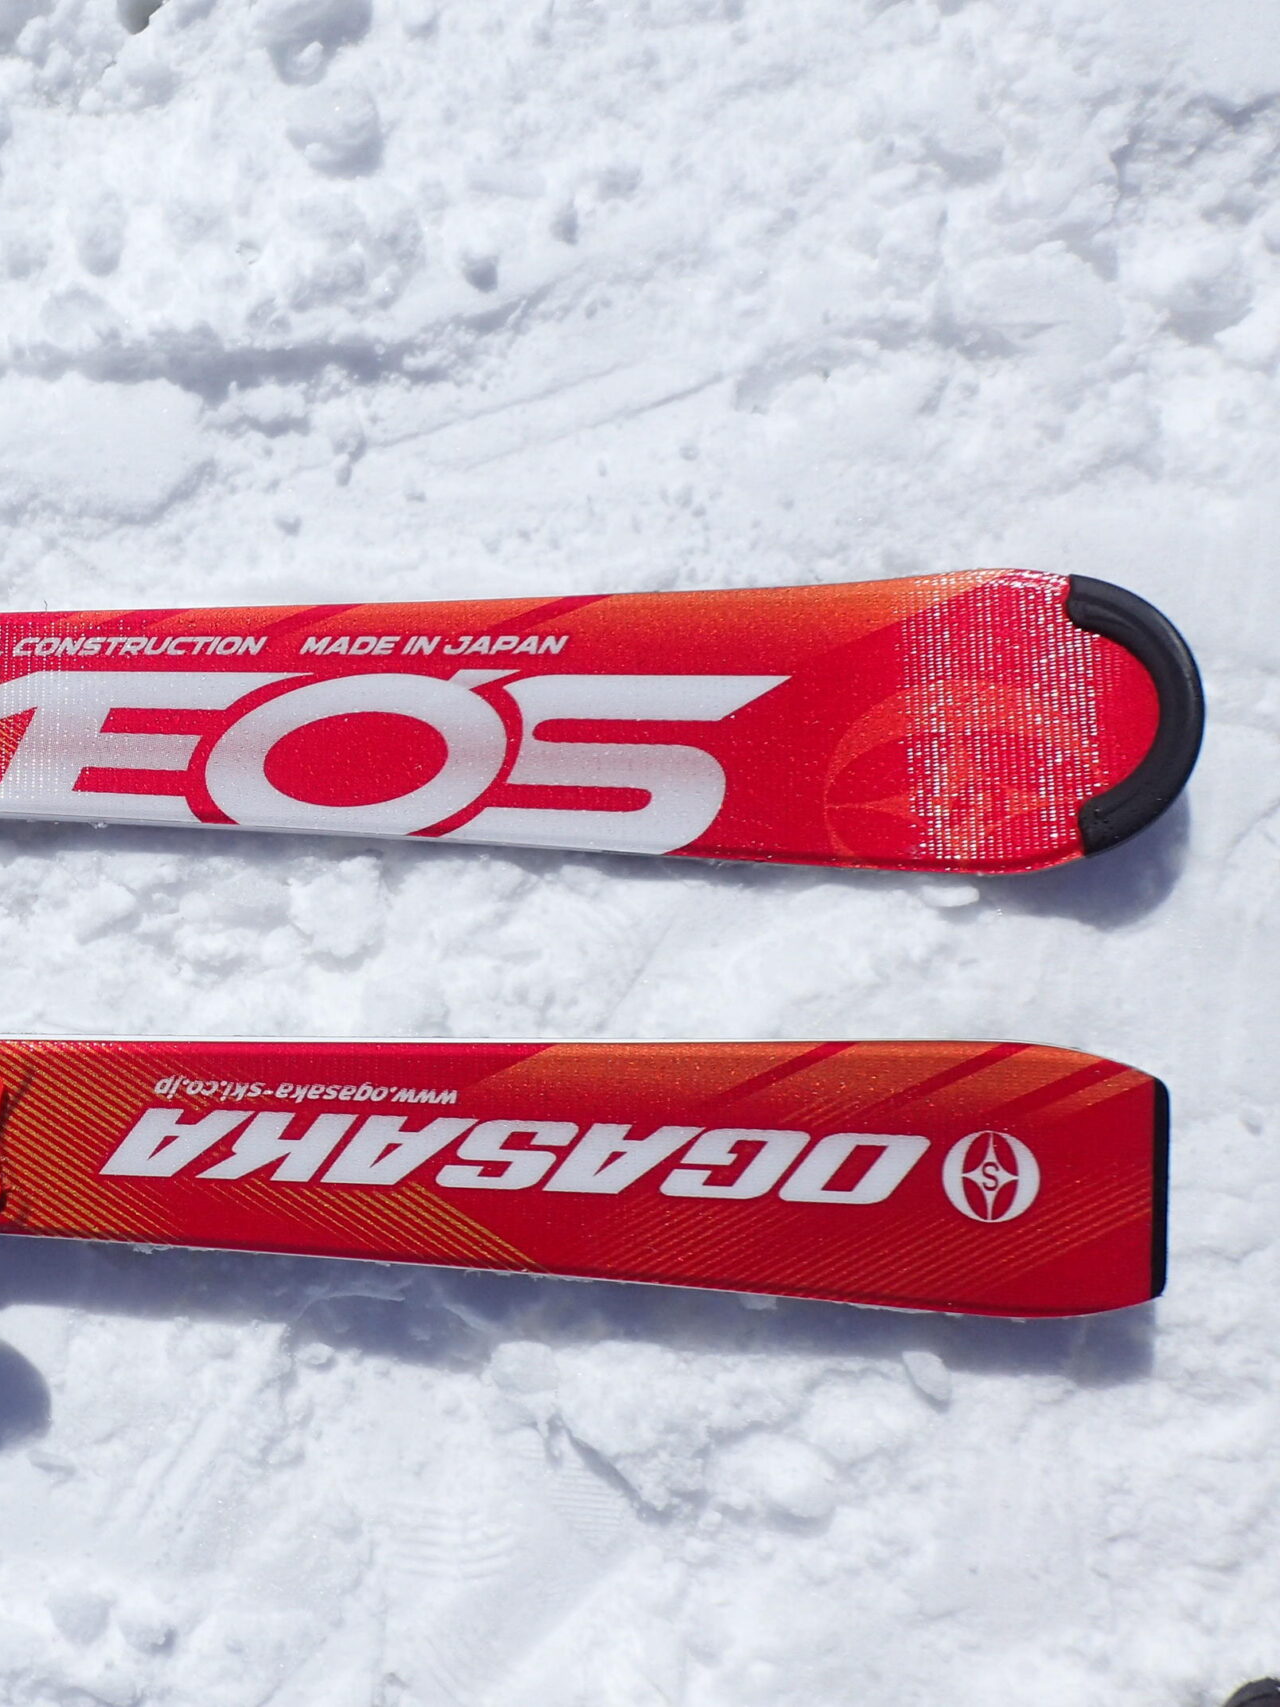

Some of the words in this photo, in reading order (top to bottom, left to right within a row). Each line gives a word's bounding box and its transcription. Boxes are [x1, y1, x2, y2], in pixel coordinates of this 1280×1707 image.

[13, 635, 268, 657] CONSTRUCTION
[299, 635, 400, 656] MADE
[401, 635, 438, 656] IN
[444, 635, 569, 656] JAPAN
[154, 1075, 458, 1107] www.ogasaka-ski.co.jp
[99, 1108, 931, 1204] OGASAKA
